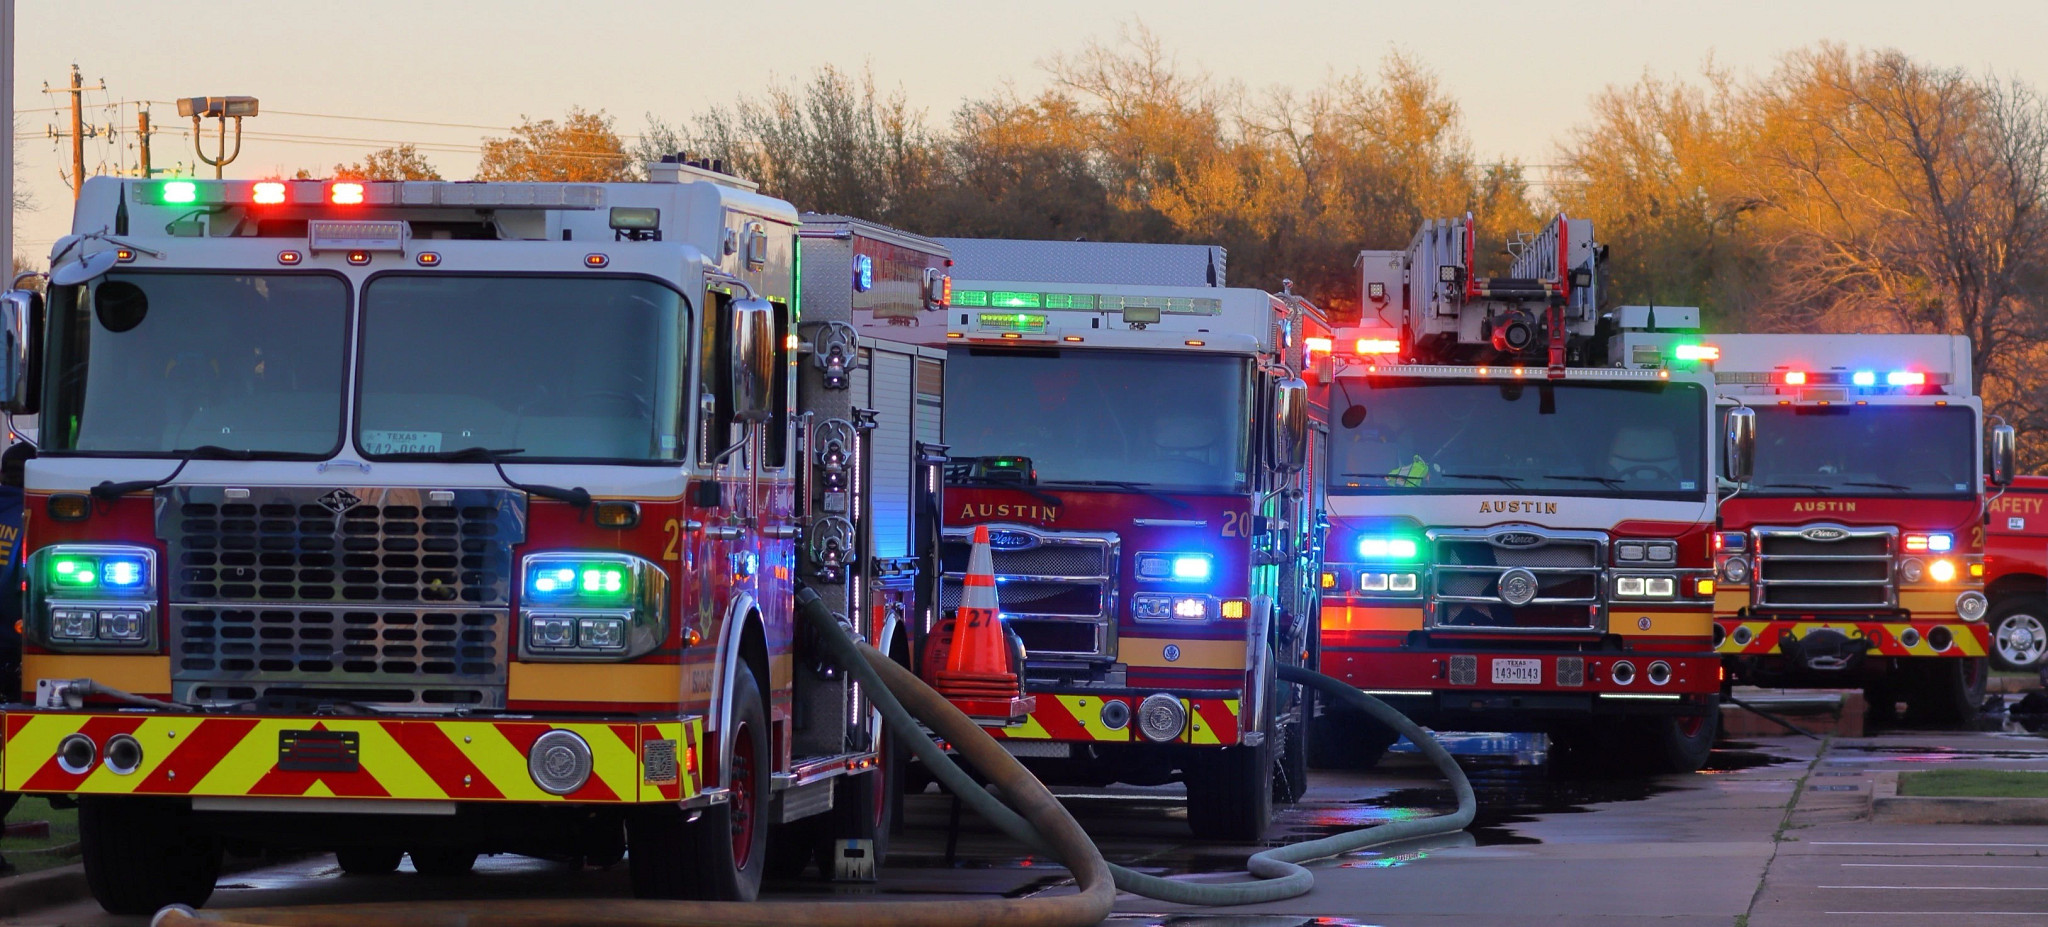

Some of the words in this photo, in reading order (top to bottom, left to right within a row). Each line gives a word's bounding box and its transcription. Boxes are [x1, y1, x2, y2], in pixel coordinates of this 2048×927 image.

[387, 432, 417, 440] TEXAS
[960, 503, 1056, 522] AUSTIN
[1479, 500, 1558, 514] AUSTIN
[1792, 501, 1857, 512] AUSTIN
[1986, 496, 2043, 514] AFETY
[0, 524, 18, 541] IN
[1221, 510, 1250, 538] 20
[661, 518, 682, 560] 2
[1501, 533, 1535, 544] Pierce
[1810, 530, 1839, 538] Pierce
[1971, 526, 1983, 548] 2
[968, 609, 993, 628] 27
